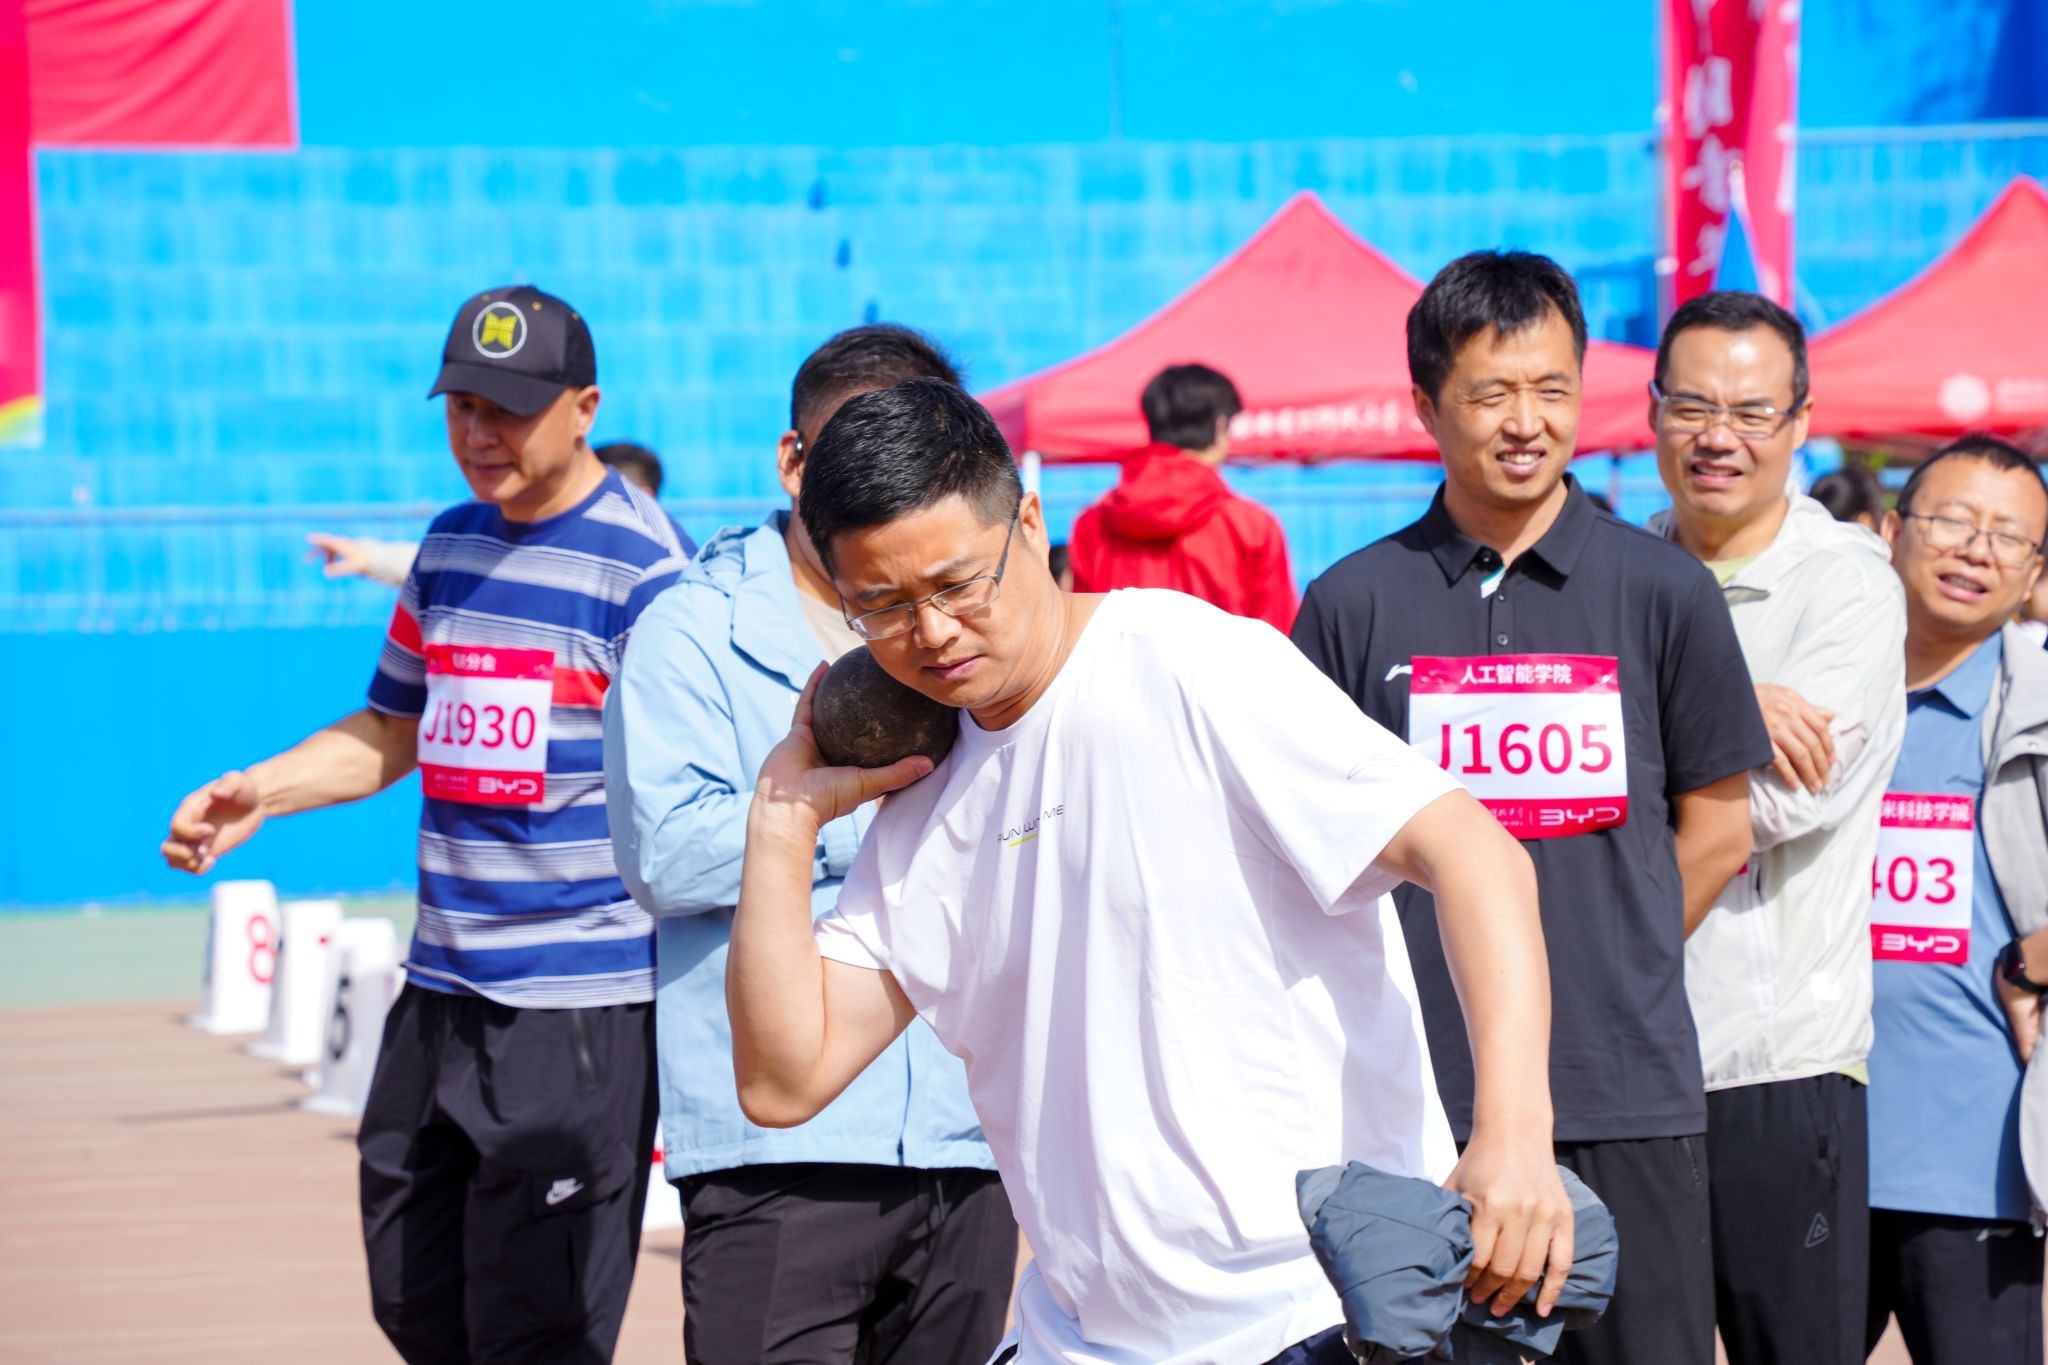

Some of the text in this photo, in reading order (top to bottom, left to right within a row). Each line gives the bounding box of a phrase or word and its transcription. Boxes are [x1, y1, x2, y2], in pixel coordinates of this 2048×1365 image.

[1460, 664, 1572, 685] 人工智能学院
[424, 700, 536, 750] J1930
[1439, 723, 1612, 775] J1605
[478, 776, 538, 796] BYD
[1539, 807, 1620, 826] BYD
[1881, 933, 1961, 954] BYD
